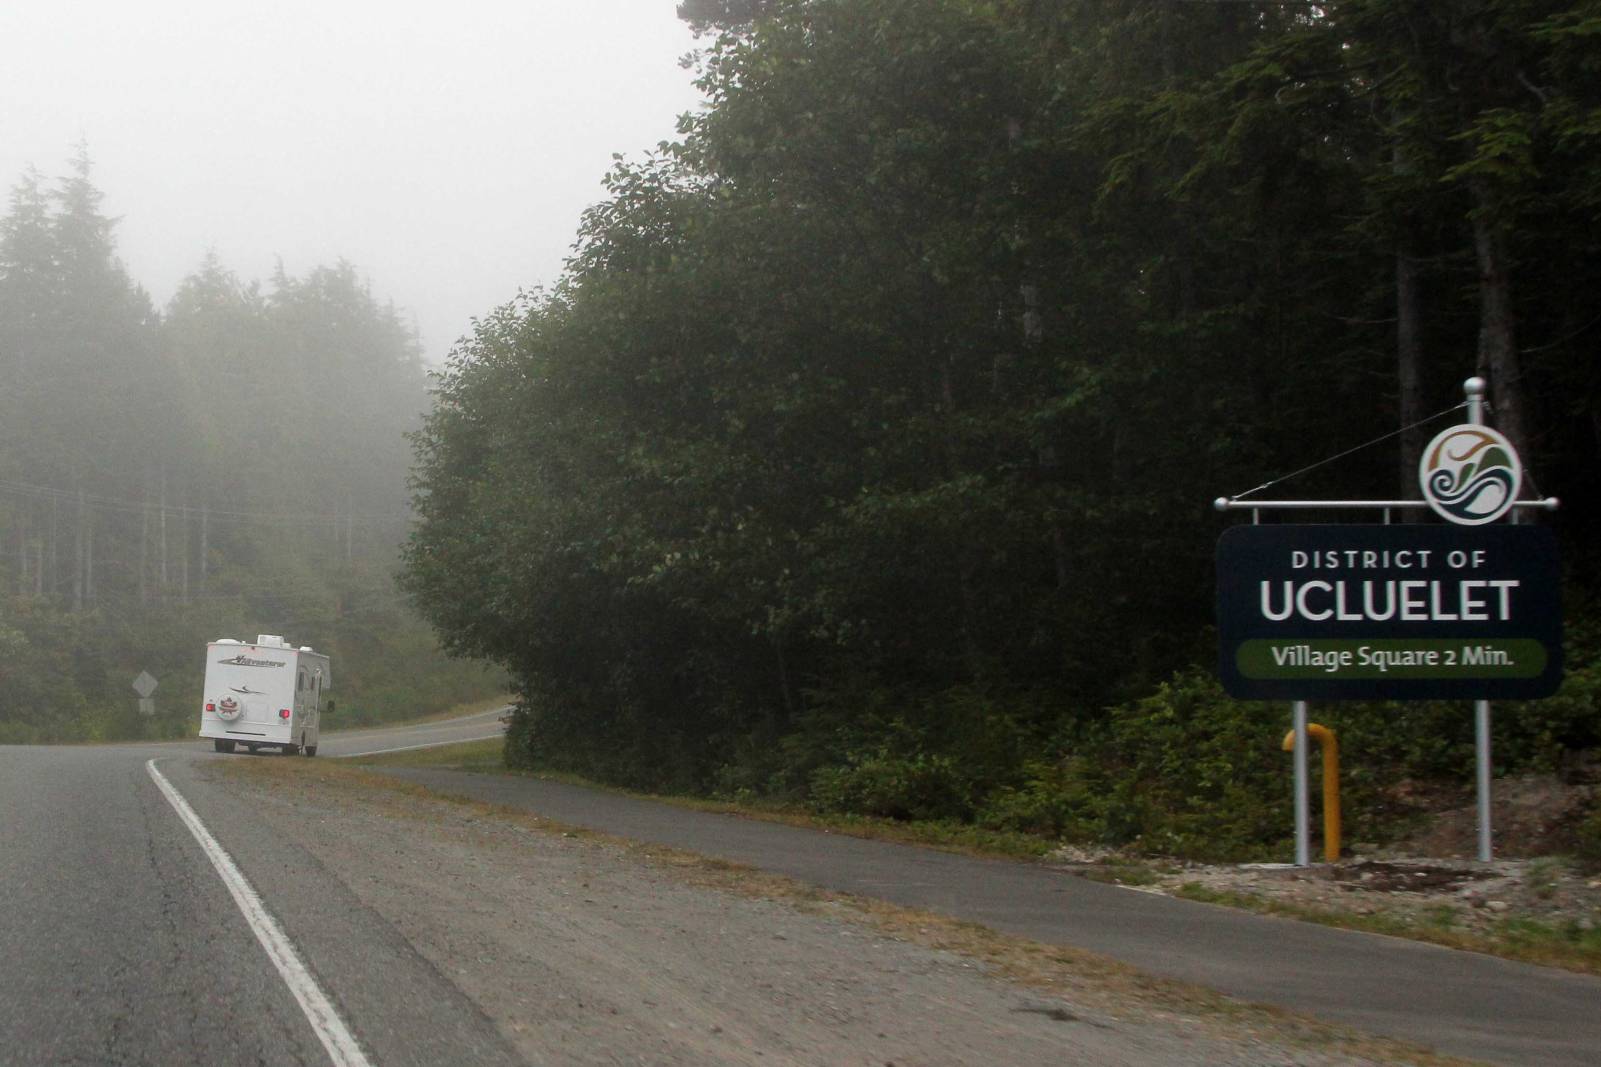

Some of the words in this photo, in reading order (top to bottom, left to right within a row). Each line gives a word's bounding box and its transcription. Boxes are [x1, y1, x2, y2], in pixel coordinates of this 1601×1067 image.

[1292, 550, 1432, 569] DISTRICT
[1447, 550, 1487, 569] OF
[1260, 580, 1520, 621] UCLUELET
[1271, 645, 1352, 672] Village
[1358, 646, 1439, 672] Square
[1444, 650, 1457, 666] 2
[1462, 645, 1514, 666] Min.
